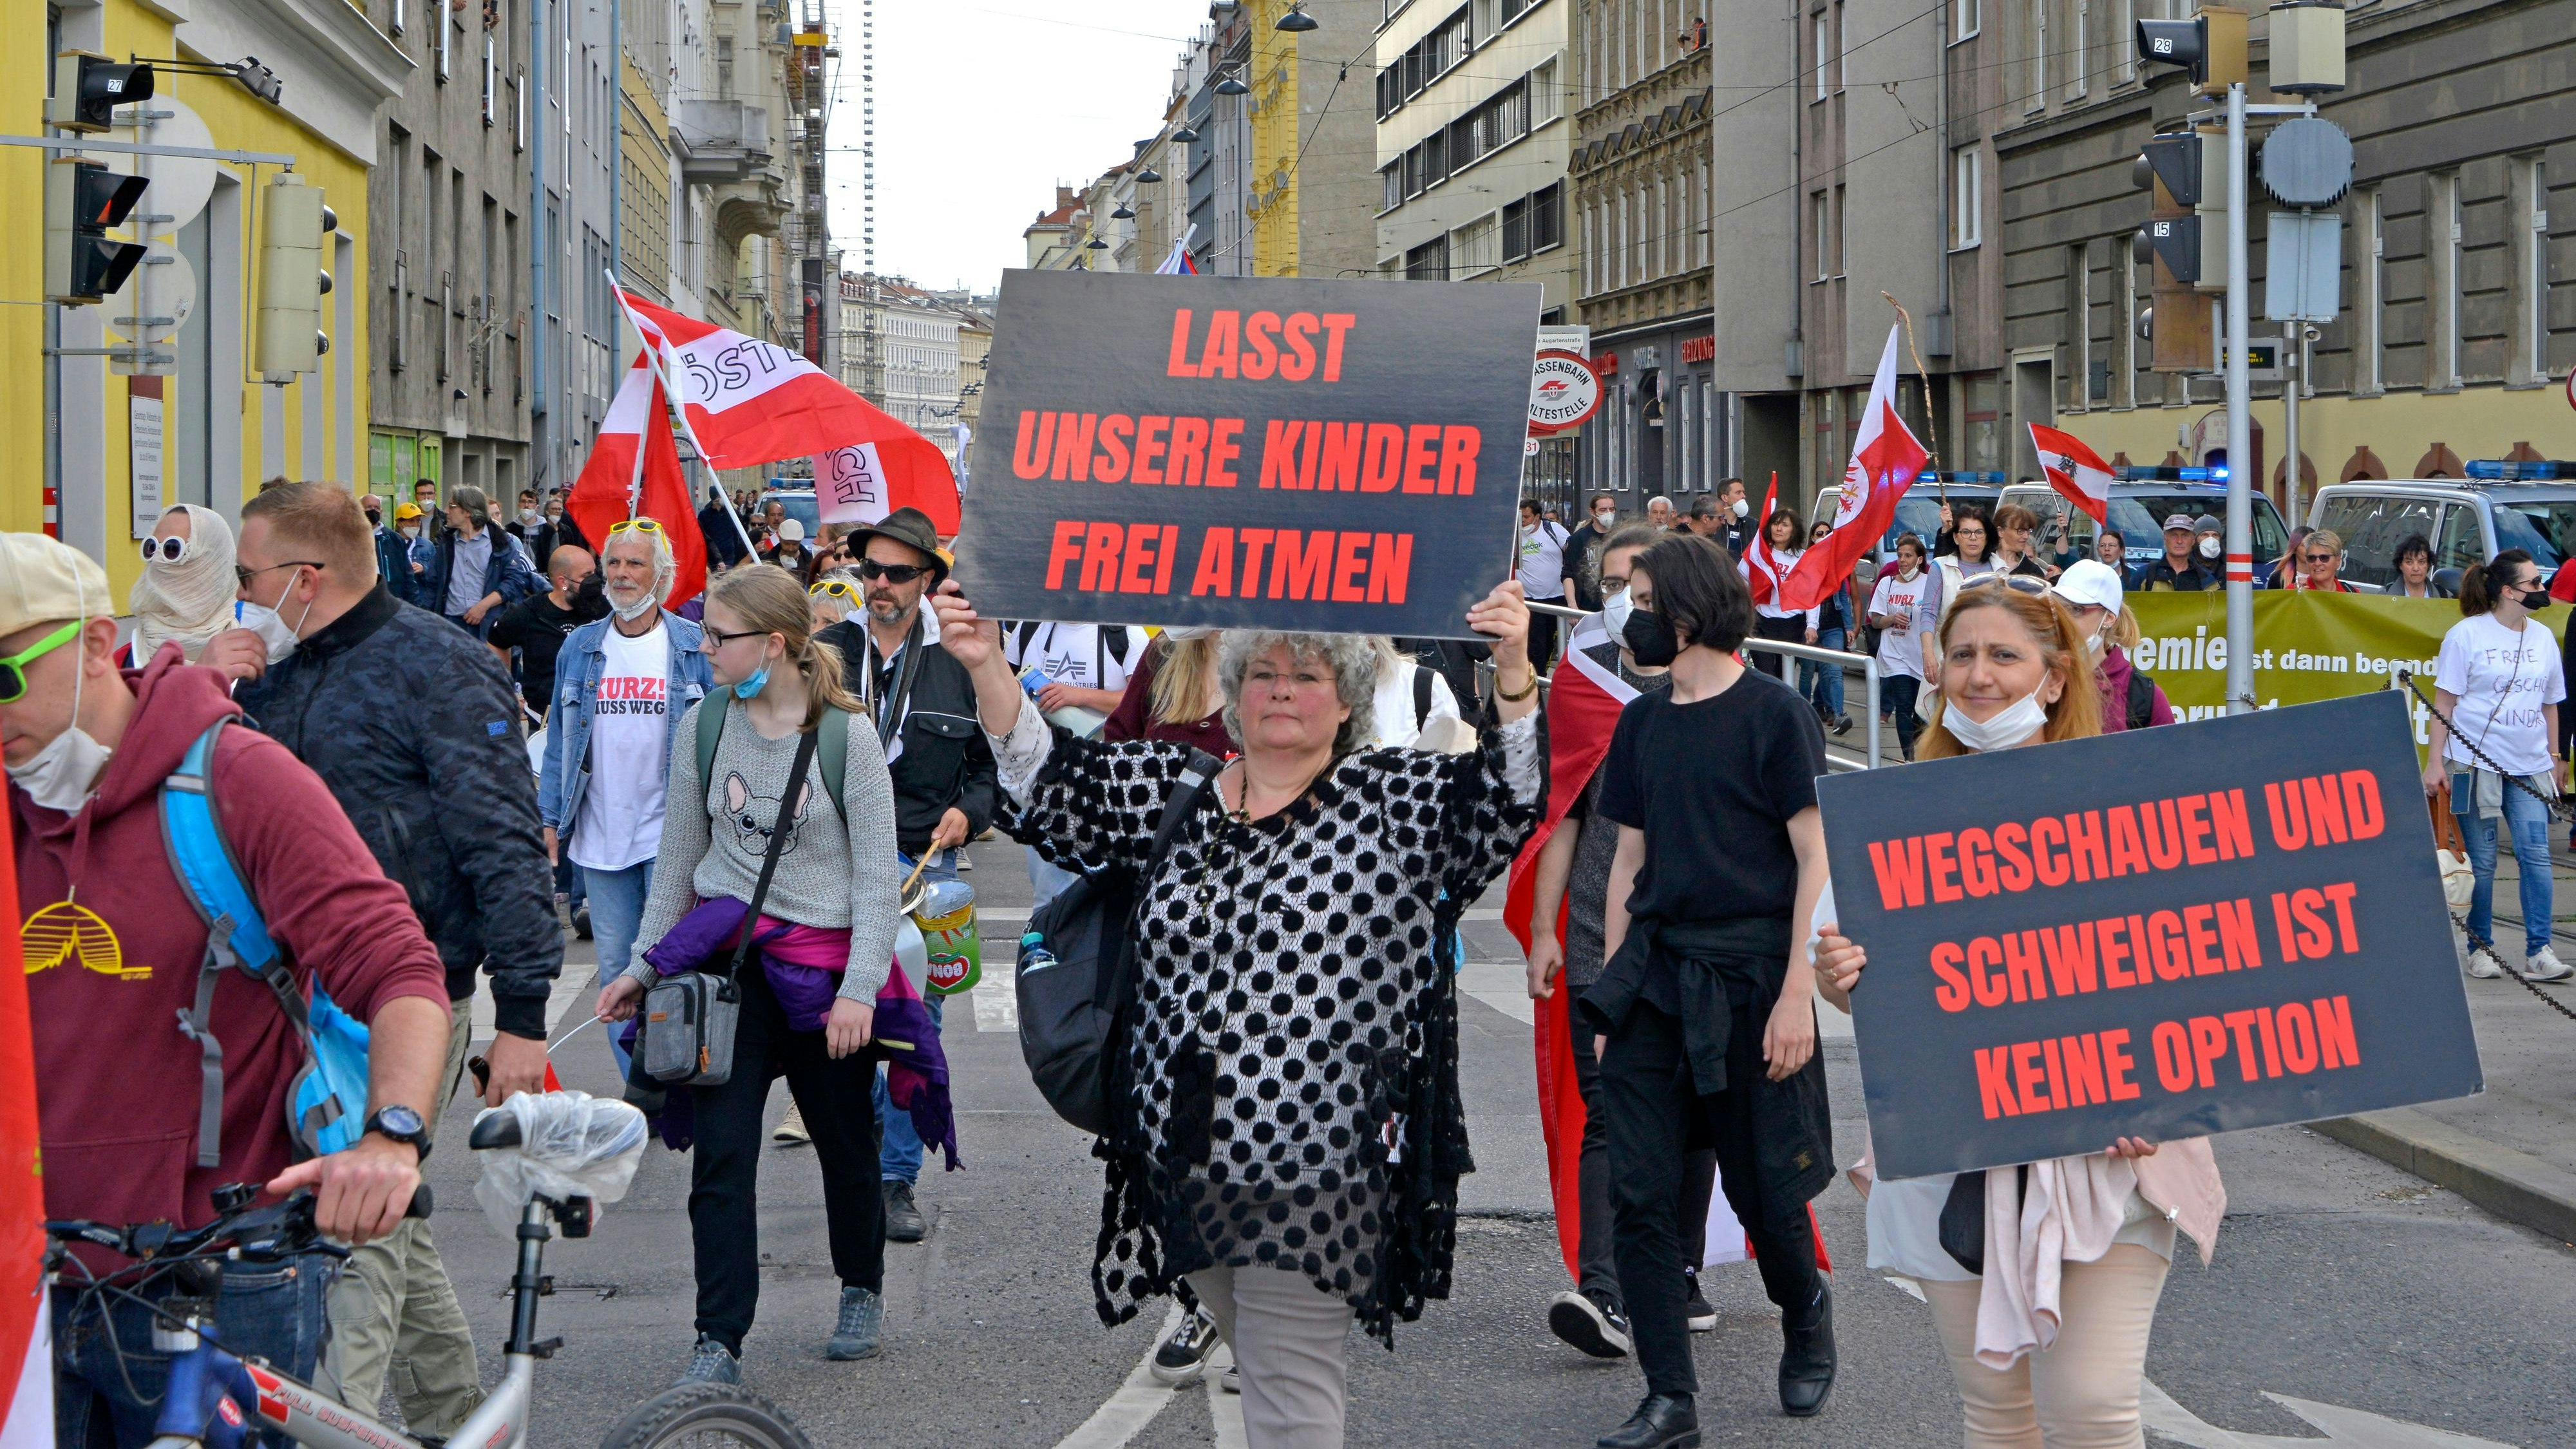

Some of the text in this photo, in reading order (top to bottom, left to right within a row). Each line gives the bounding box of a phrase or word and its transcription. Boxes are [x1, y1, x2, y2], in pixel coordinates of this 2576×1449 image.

[2155, 39, 2171, 52] 28
[109, 80, 122, 90] 27
[2155, 223, 2168, 236] 15
[1168, 309, 1355, 381] LASST
[1013, 411, 1481, 495] UNSERE KINDER
[1045, 520, 1413, 603] FREI ATMEN
[2280, 649, 2348, 672] dann
[2485, 649, 2538, 665] FREIE
[629, 700, 665, 715] WEG
[1868, 770, 2384, 909] WEGSCHAUEN UND
[1931, 882, 2359, 1012] SCHWEIGEN IST
[1975, 996, 2360, 1119] KEINE OPTION
